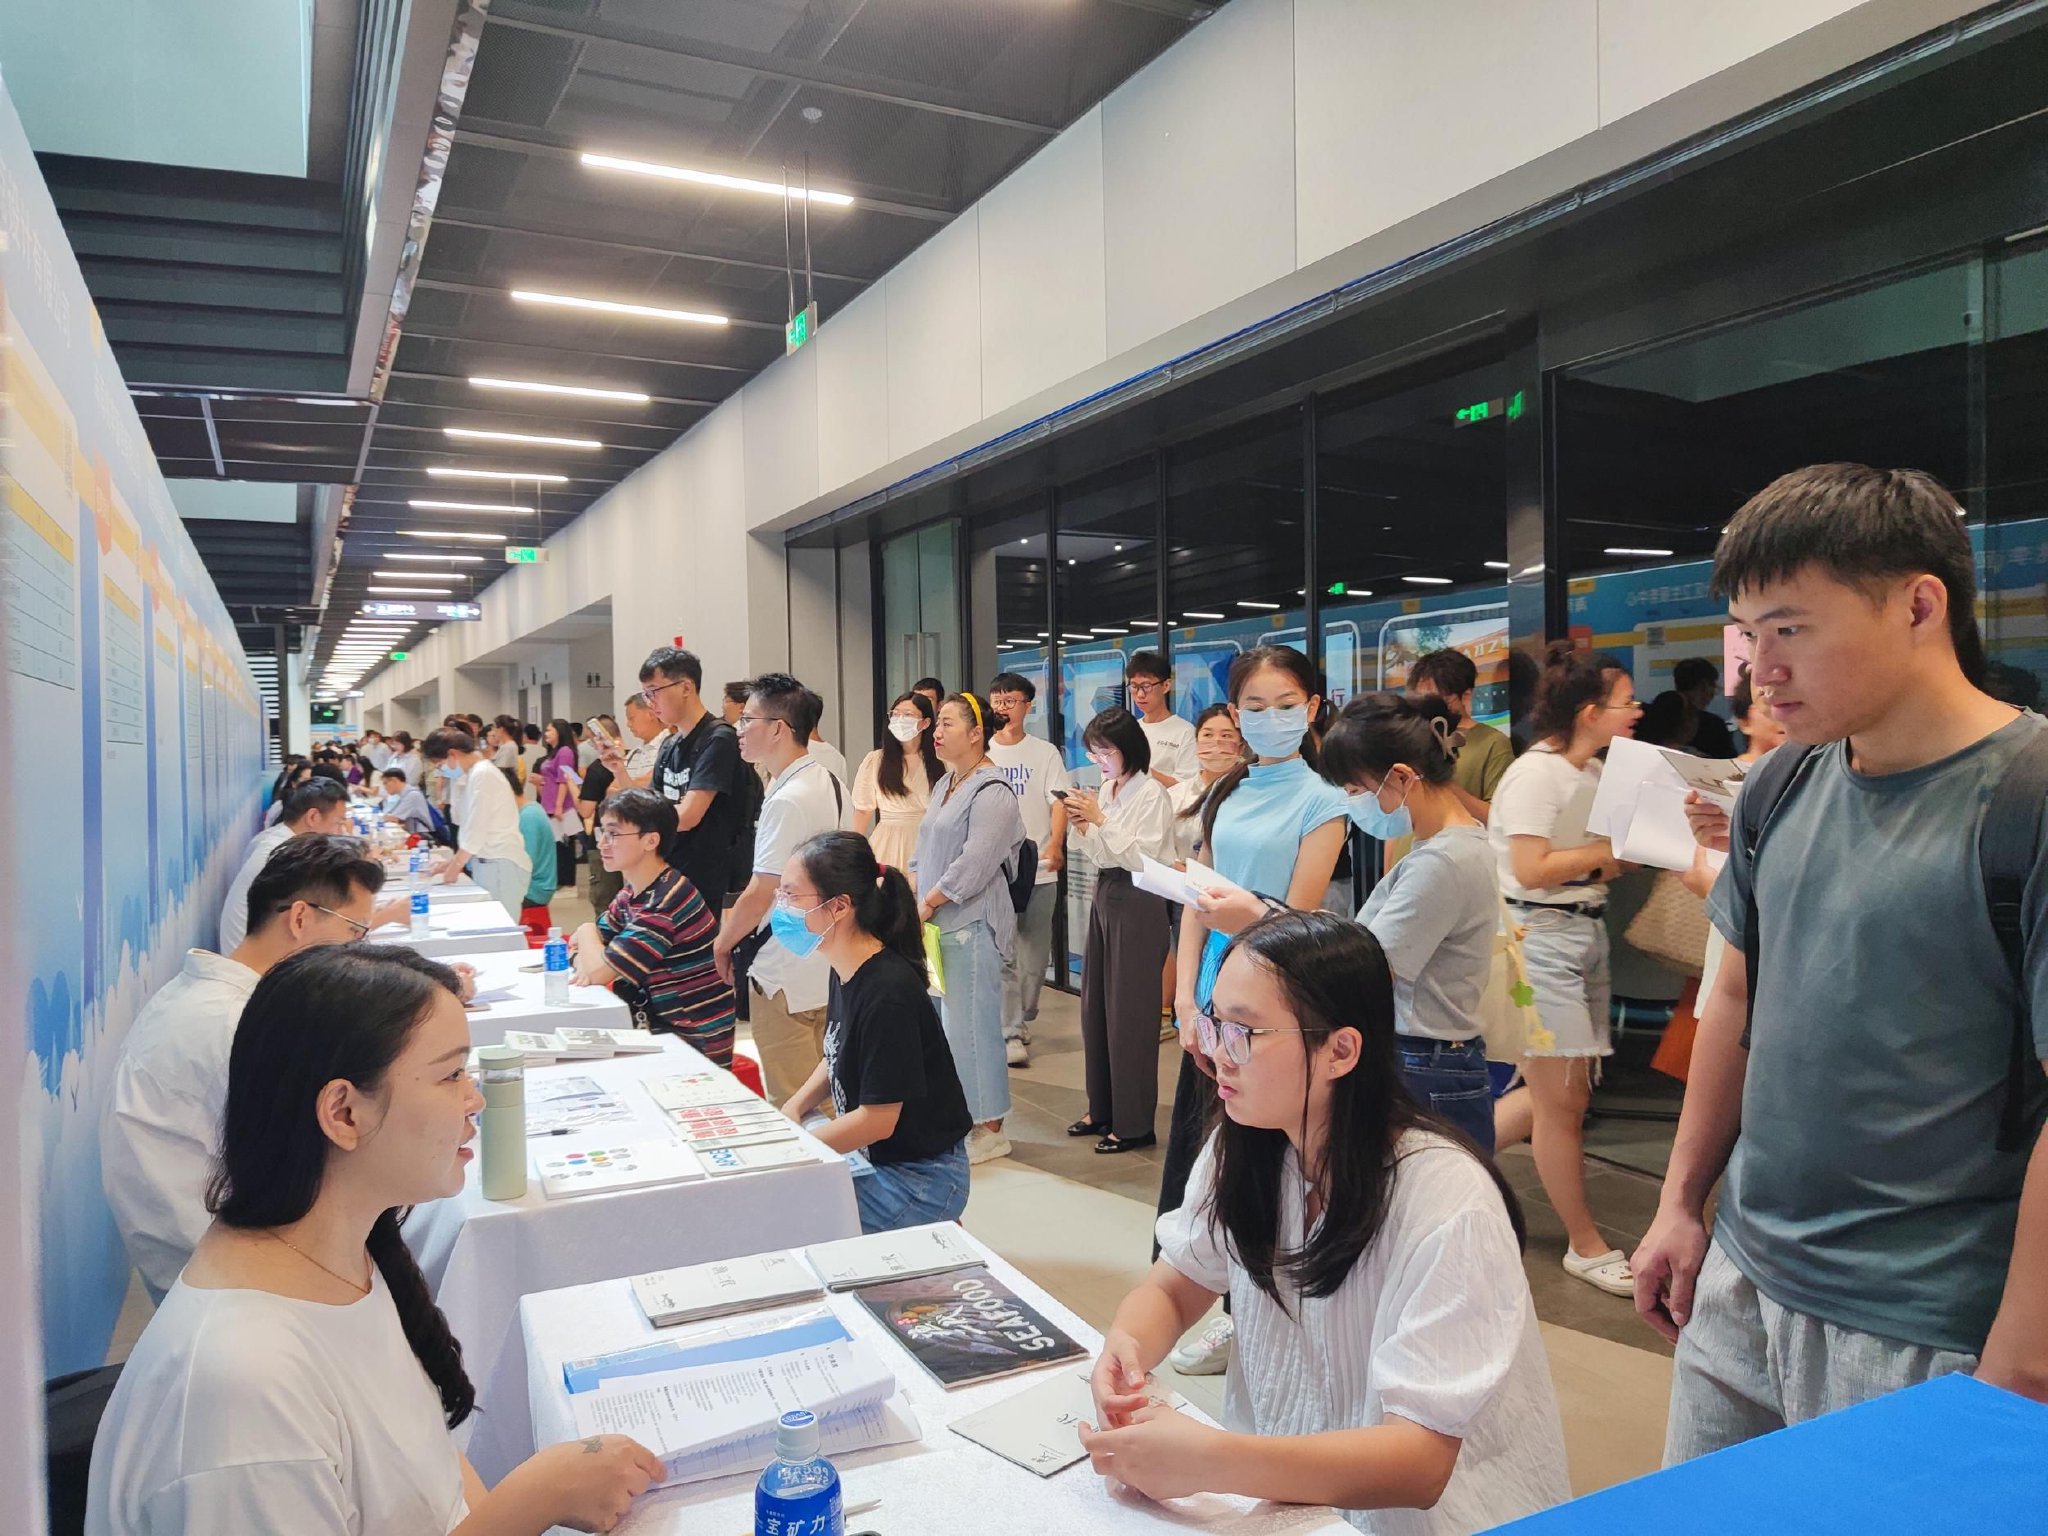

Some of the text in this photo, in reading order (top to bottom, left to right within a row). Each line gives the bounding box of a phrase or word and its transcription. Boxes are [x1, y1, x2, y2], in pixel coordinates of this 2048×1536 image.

[952, 1278, 1055, 1351] SEAFOOD
[765, 1514, 826, 1536] 宝矿力
